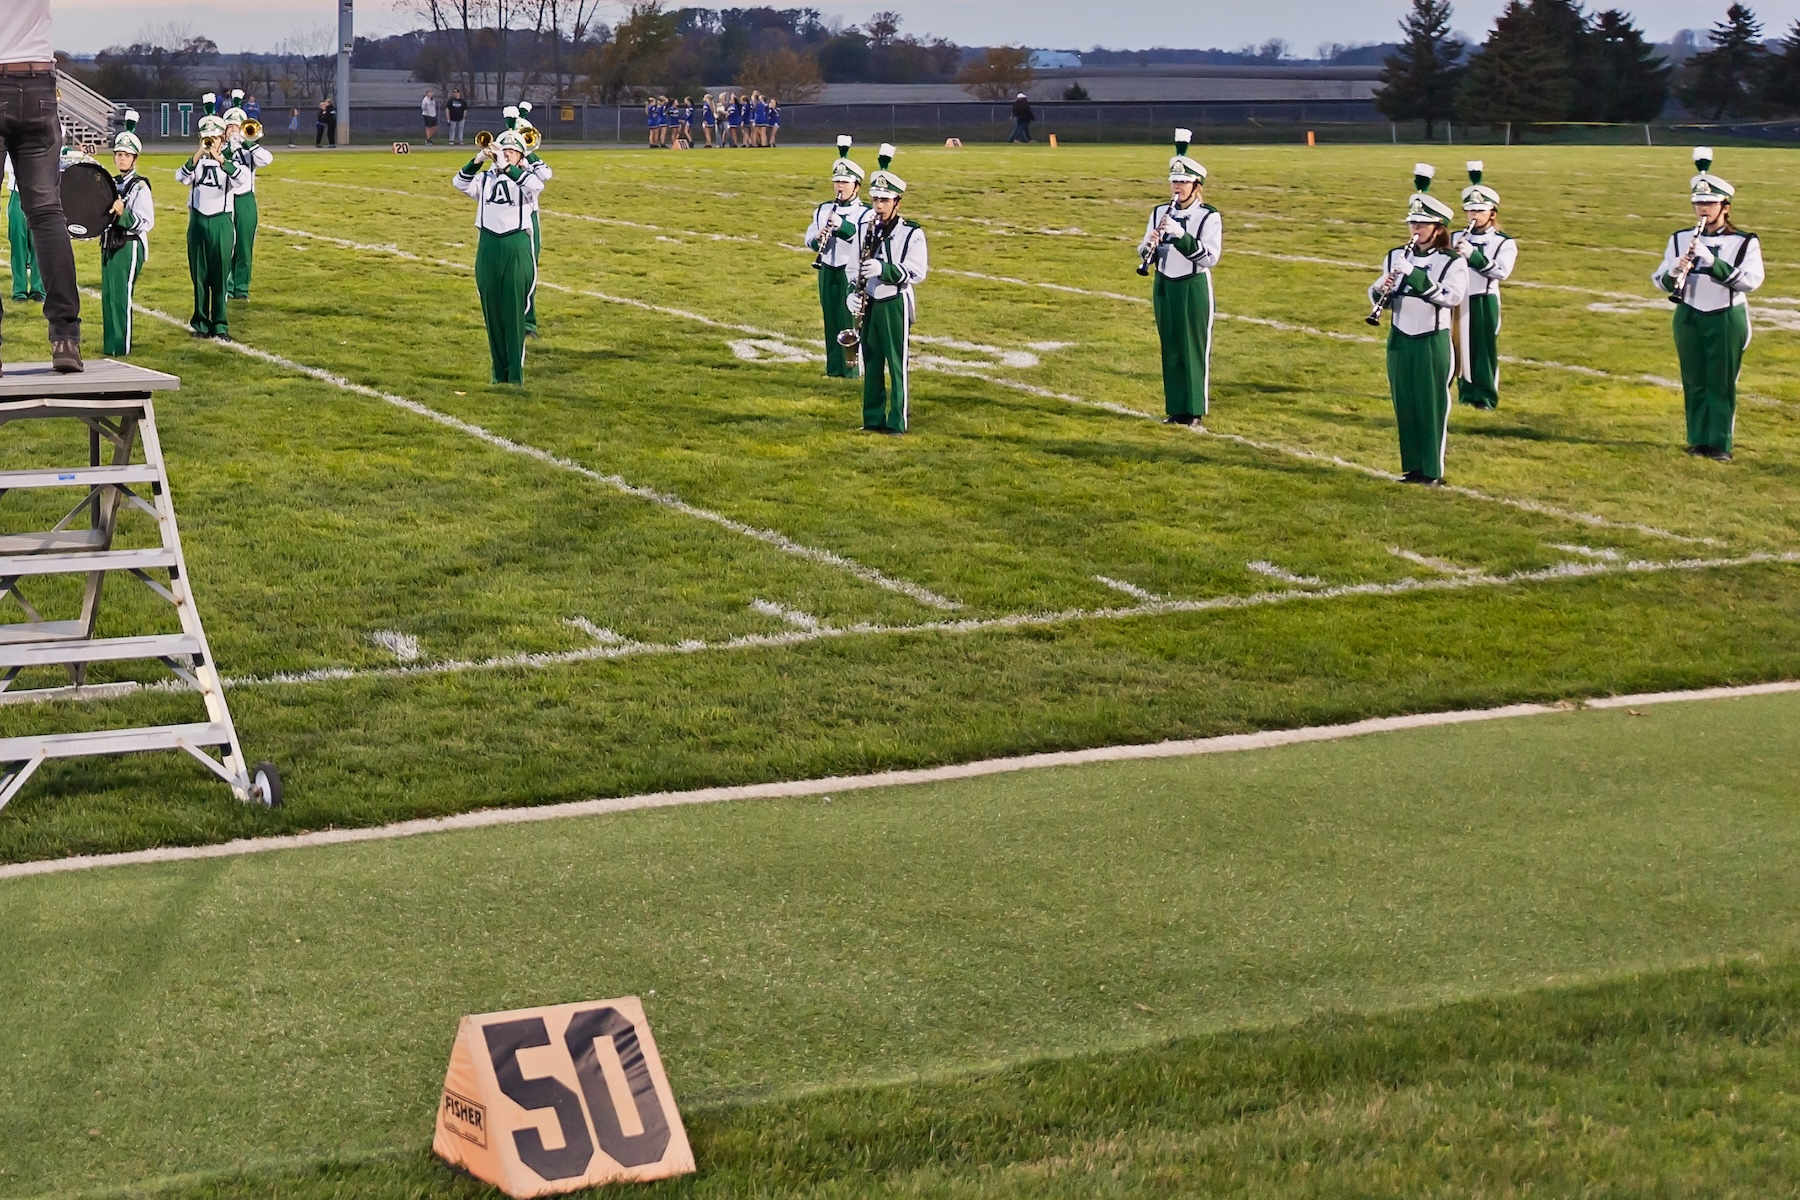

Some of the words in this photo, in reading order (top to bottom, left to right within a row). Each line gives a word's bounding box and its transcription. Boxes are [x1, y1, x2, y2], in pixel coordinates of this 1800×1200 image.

[82, 143, 96, 155] 30
[394, 143, 409, 154] 20
[201, 168, 220, 187] A
[493, 182, 510, 204] A
[481, 1006, 672, 1182] 50
[445, 1095, 483, 1131] FISHER
